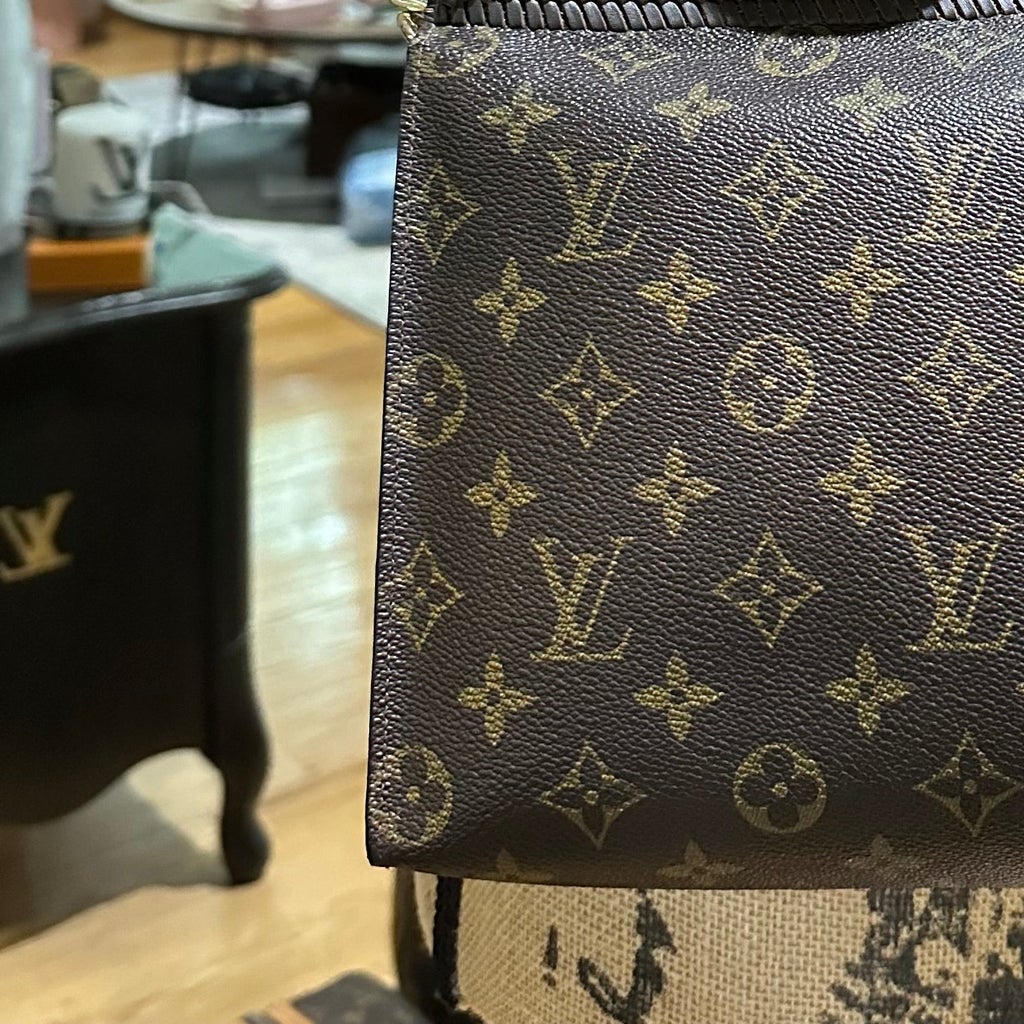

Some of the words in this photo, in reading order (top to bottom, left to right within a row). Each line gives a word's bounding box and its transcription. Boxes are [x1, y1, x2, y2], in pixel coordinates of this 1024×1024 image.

[547, 143, 648, 264] LV
[903, 128, 1007, 243] LV
[529, 535, 637, 662] LV
[900, 521, 1018, 652] LV
